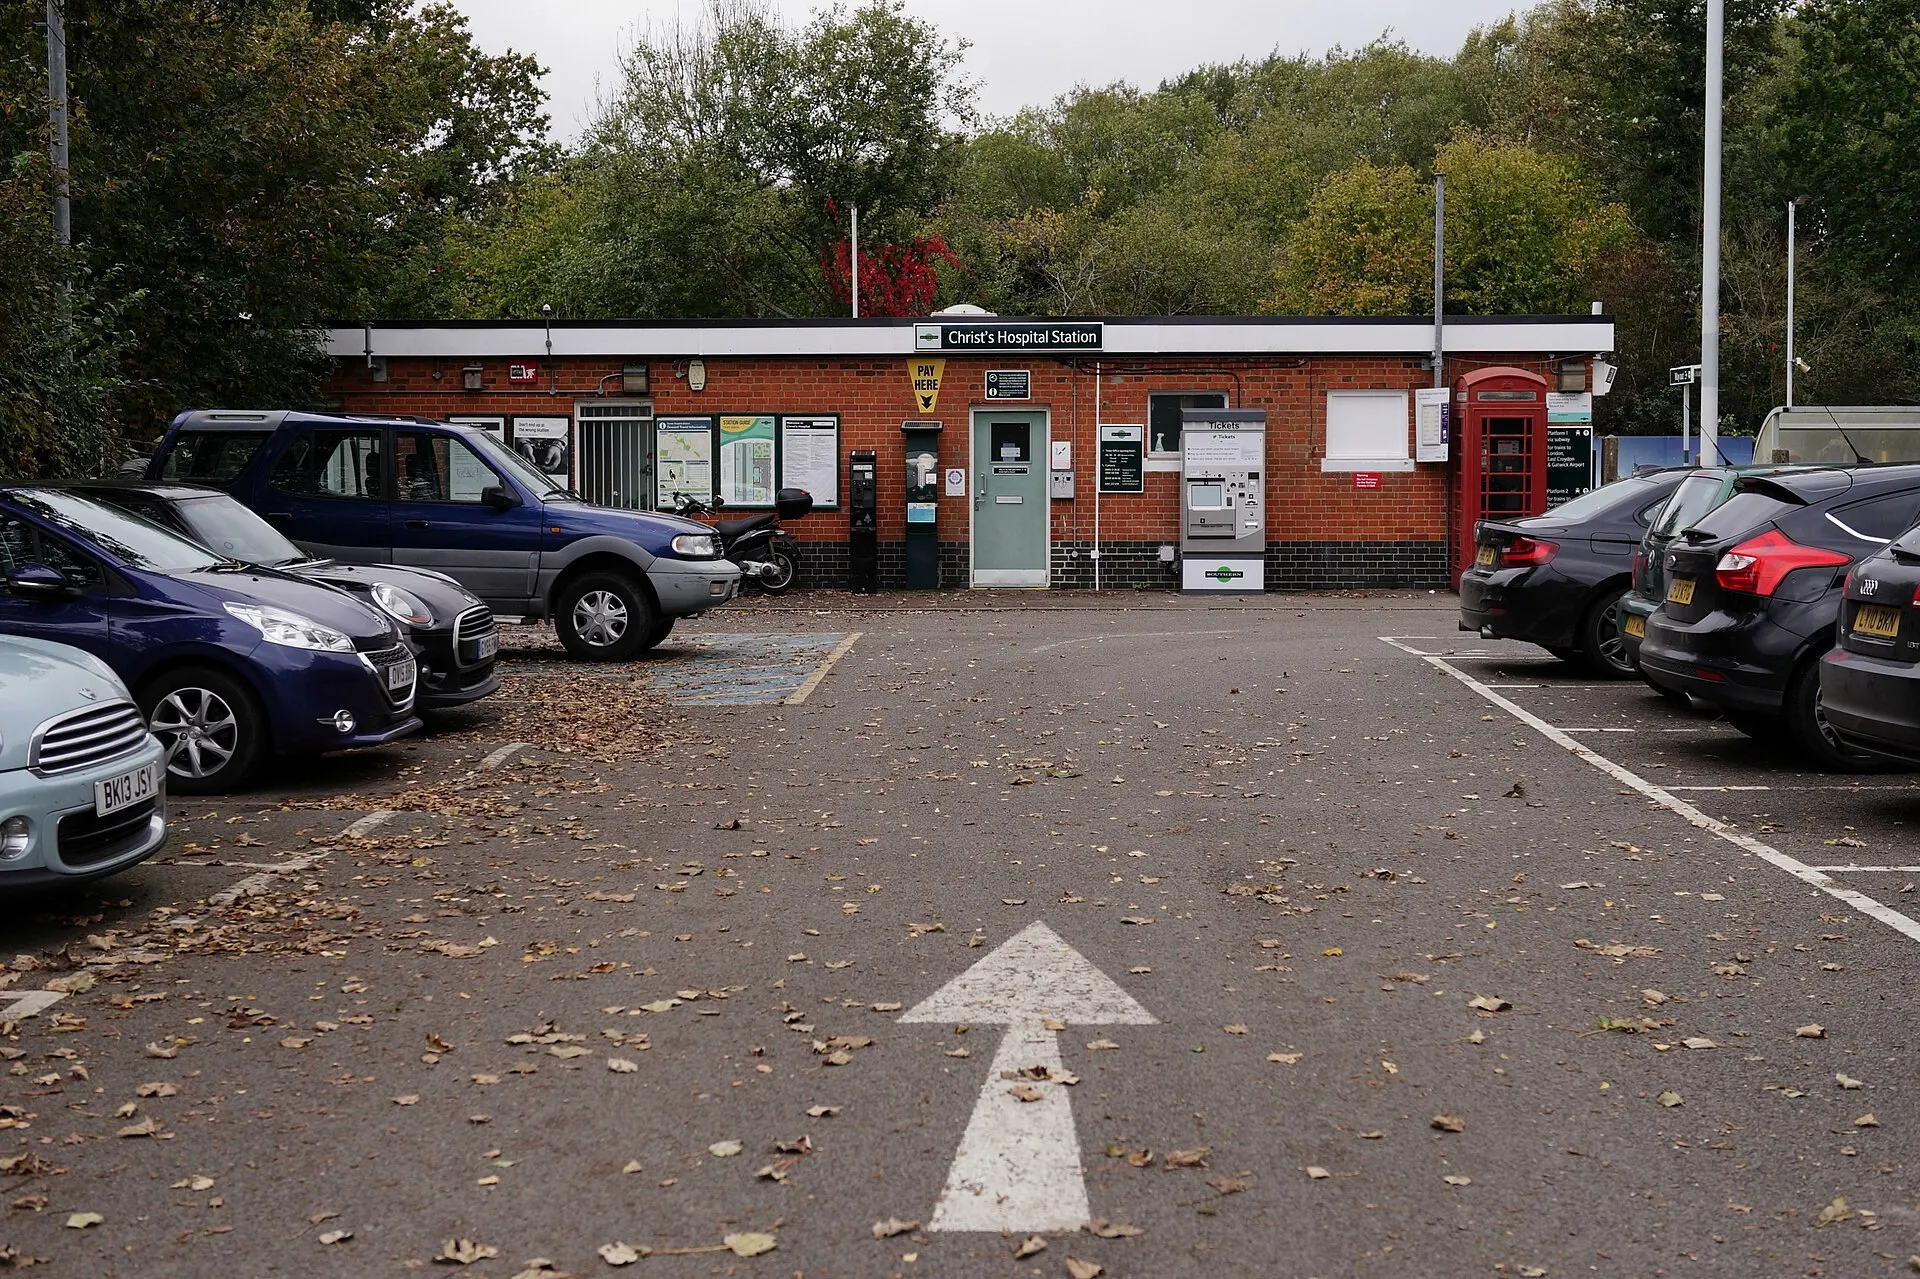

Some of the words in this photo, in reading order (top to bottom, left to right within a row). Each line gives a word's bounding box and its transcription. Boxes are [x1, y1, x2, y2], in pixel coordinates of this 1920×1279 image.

[948, 330, 994, 344] Christ's
[998, 330, 1048, 346] Hospital
[1052, 330, 1097, 344] Station
[918, 365, 936, 376] PAY
[914, 379, 938, 390] HERE
[104, 775, 131, 809] BK13
[135, 766, 152, 797] JSY
